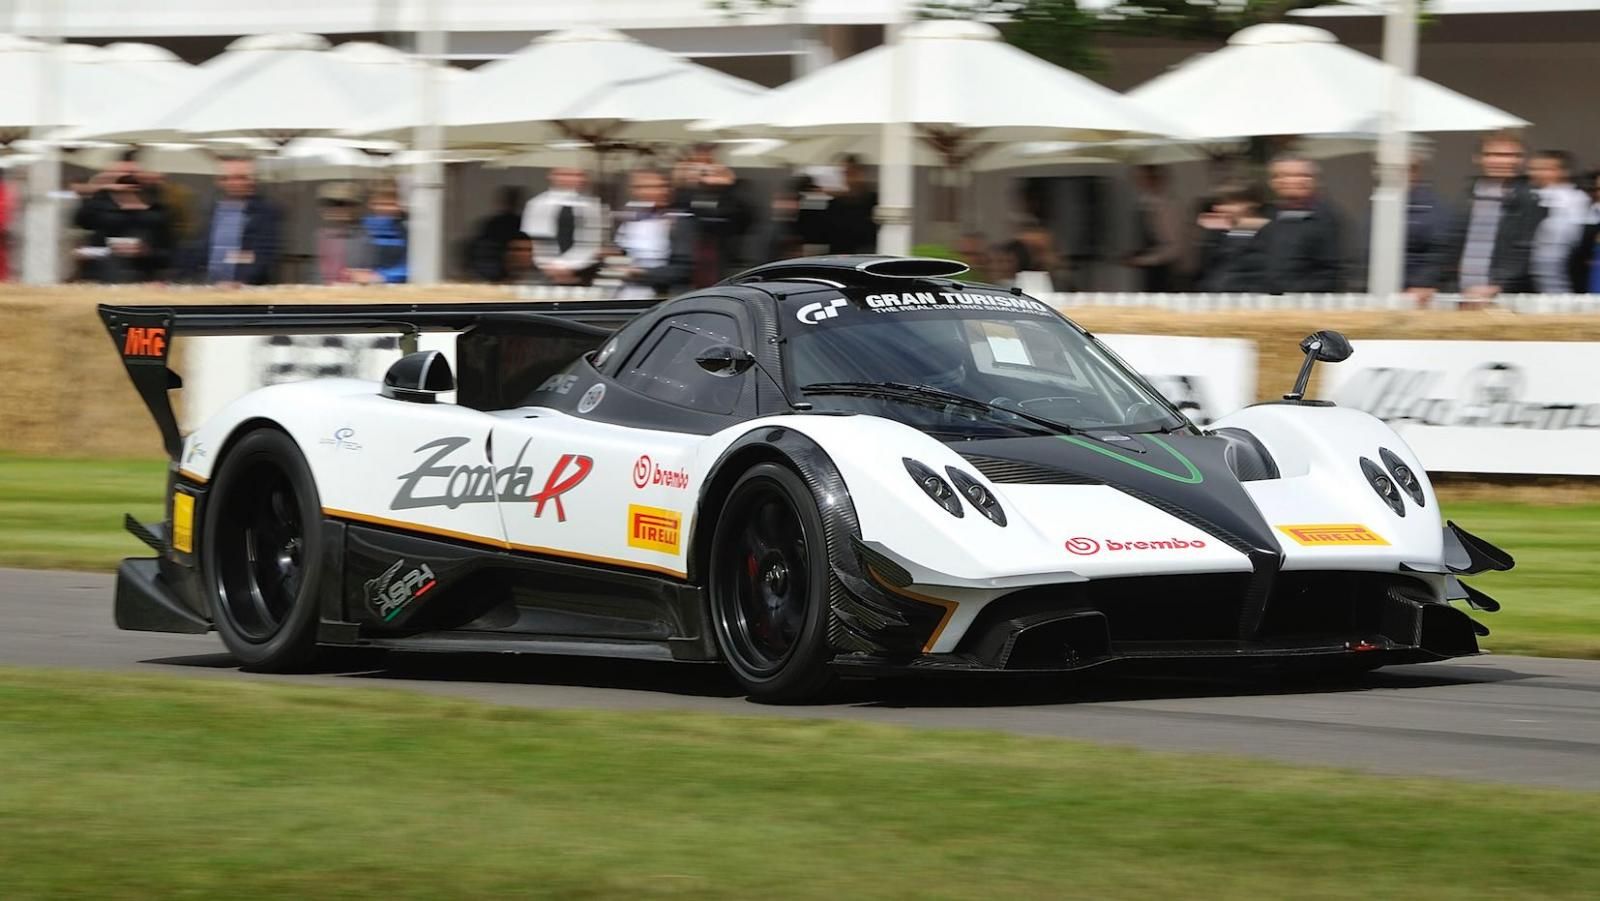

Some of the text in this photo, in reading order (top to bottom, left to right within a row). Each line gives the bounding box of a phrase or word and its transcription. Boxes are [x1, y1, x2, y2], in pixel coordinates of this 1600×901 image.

[865, 292, 1048, 312] GRAN TURISMO
[871, 306, 900, 314] THE
[898, 304, 933, 312] REAL
[390, 436, 594, 523] Zonda R
[652, 462, 690, 490] brembo
[633, 513, 678, 546] PIRELLI
[1289, 527, 1378, 542] PIRELLI
[1106, 537, 1206, 552] brembo
